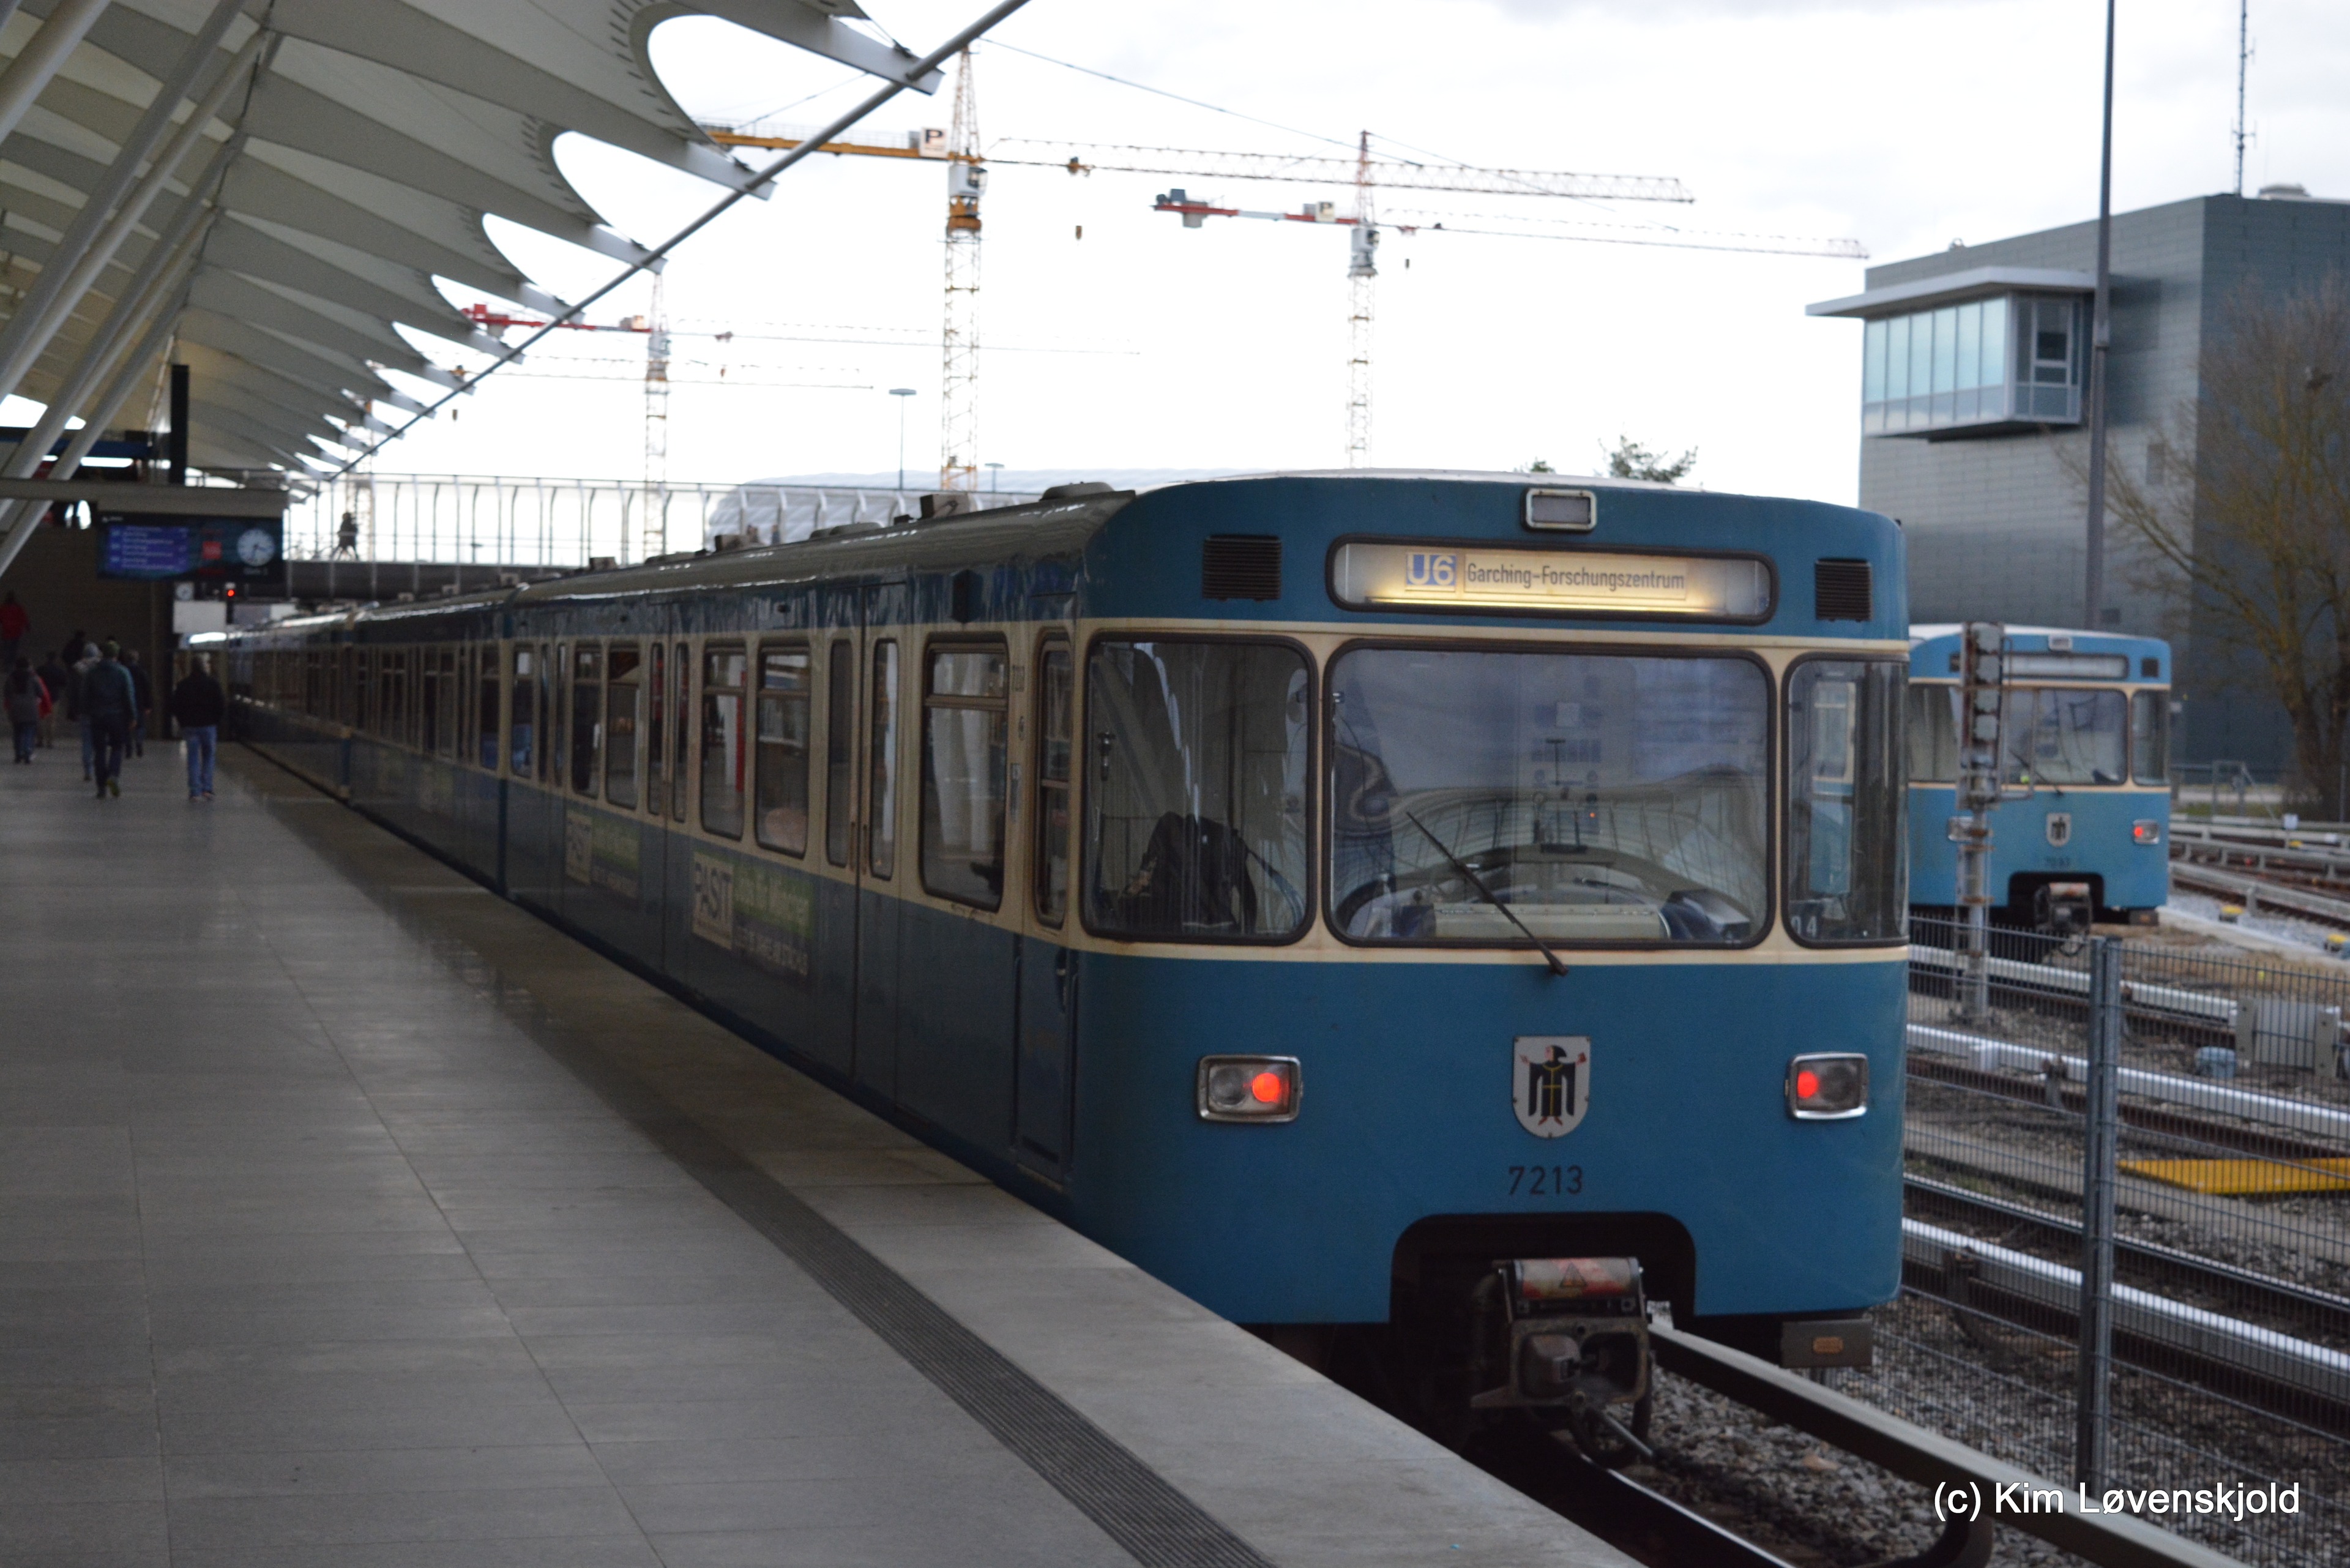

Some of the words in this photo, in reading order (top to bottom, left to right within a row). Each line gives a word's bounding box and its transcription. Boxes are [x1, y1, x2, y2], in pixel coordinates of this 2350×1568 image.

[925, 129, 944, 144] P
[1408, 554, 1455, 586] U6
[1468, 562, 1685, 591] Garching-Forschungszentrum
[1508, 1165, 1584, 1195] 7213
